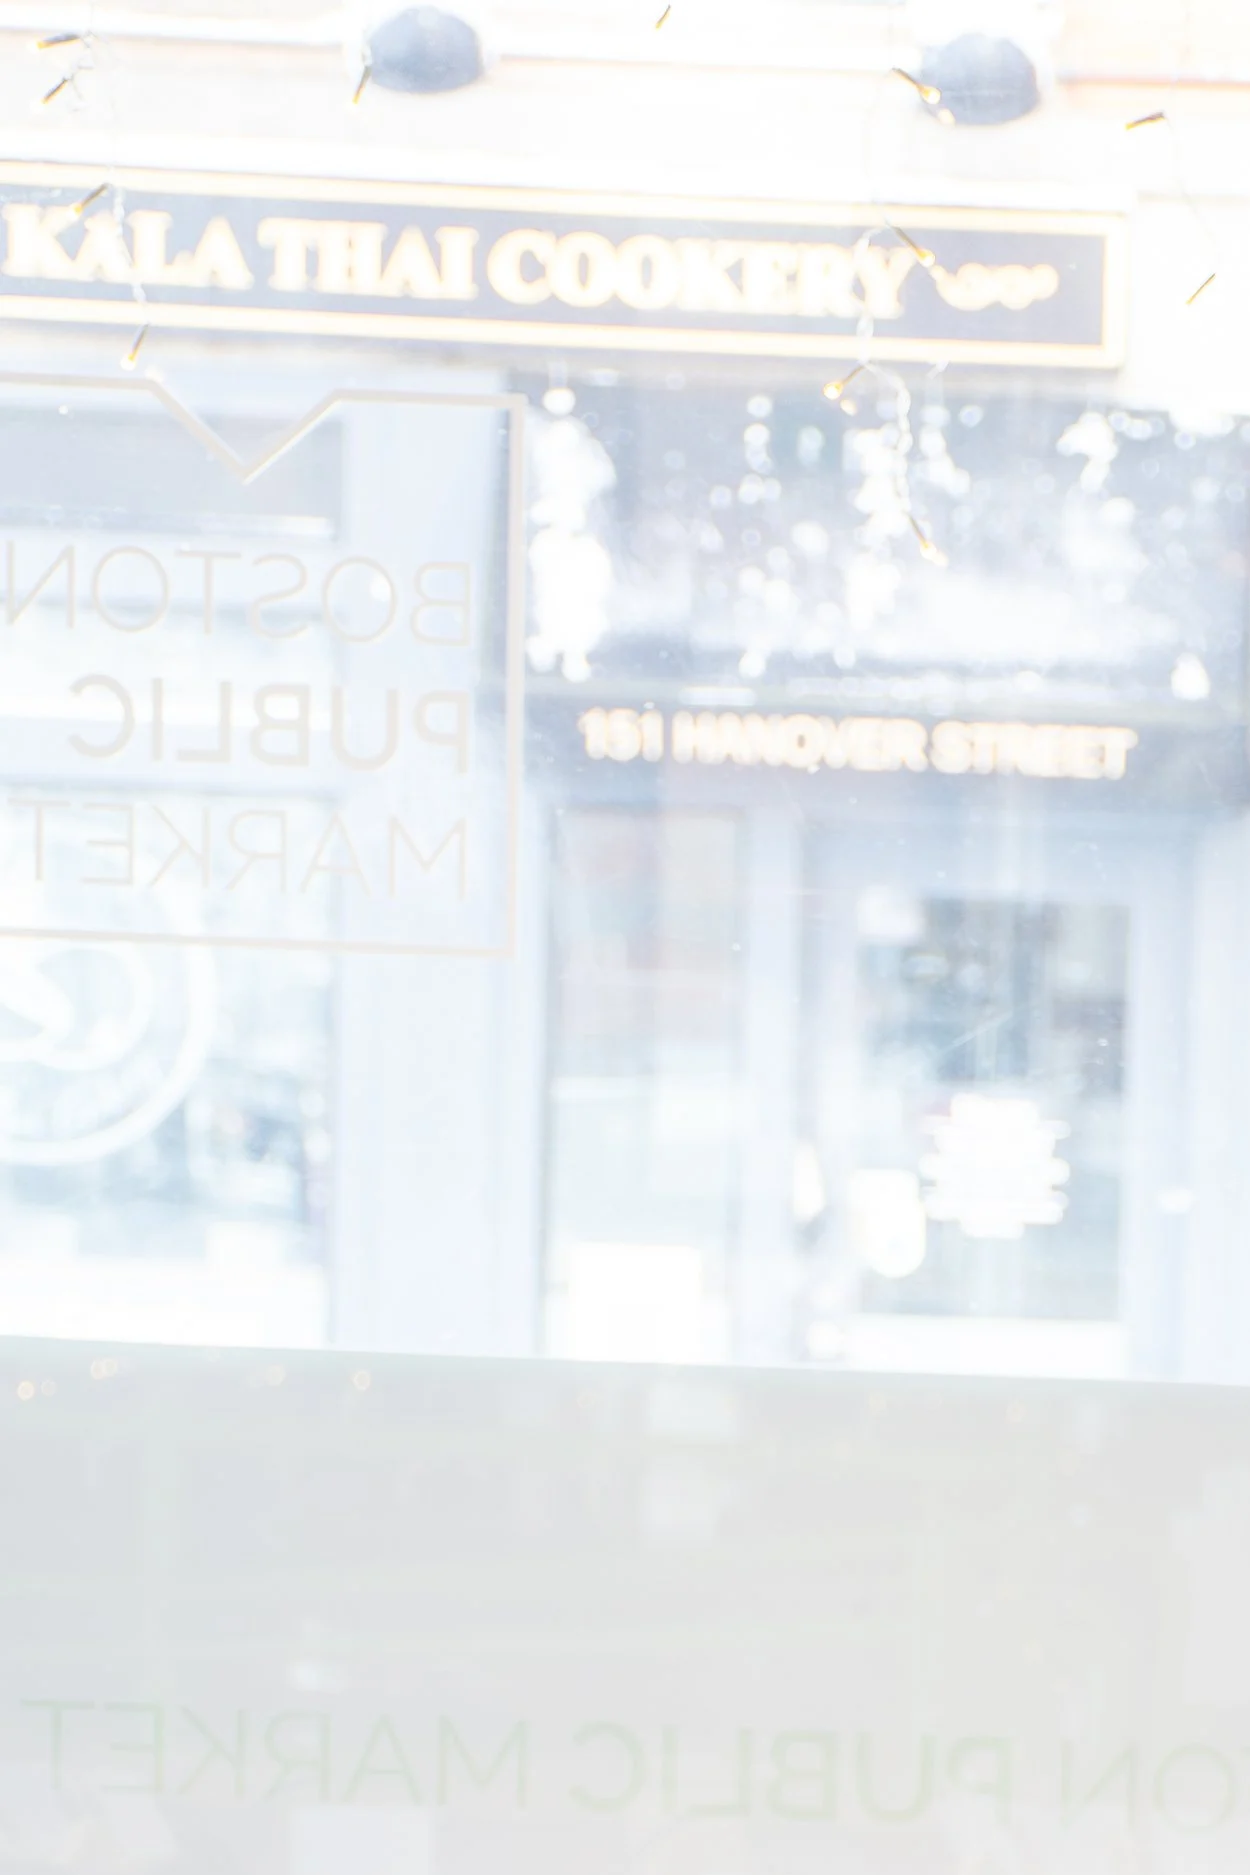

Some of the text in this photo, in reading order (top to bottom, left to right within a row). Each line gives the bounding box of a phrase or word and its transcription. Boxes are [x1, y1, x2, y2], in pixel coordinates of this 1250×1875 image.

[2, 203, 918, 320] KALA THAI COOKERY
[672, 709, 928, 772] HANOVER
[930, 719, 1138, 780] STREET
